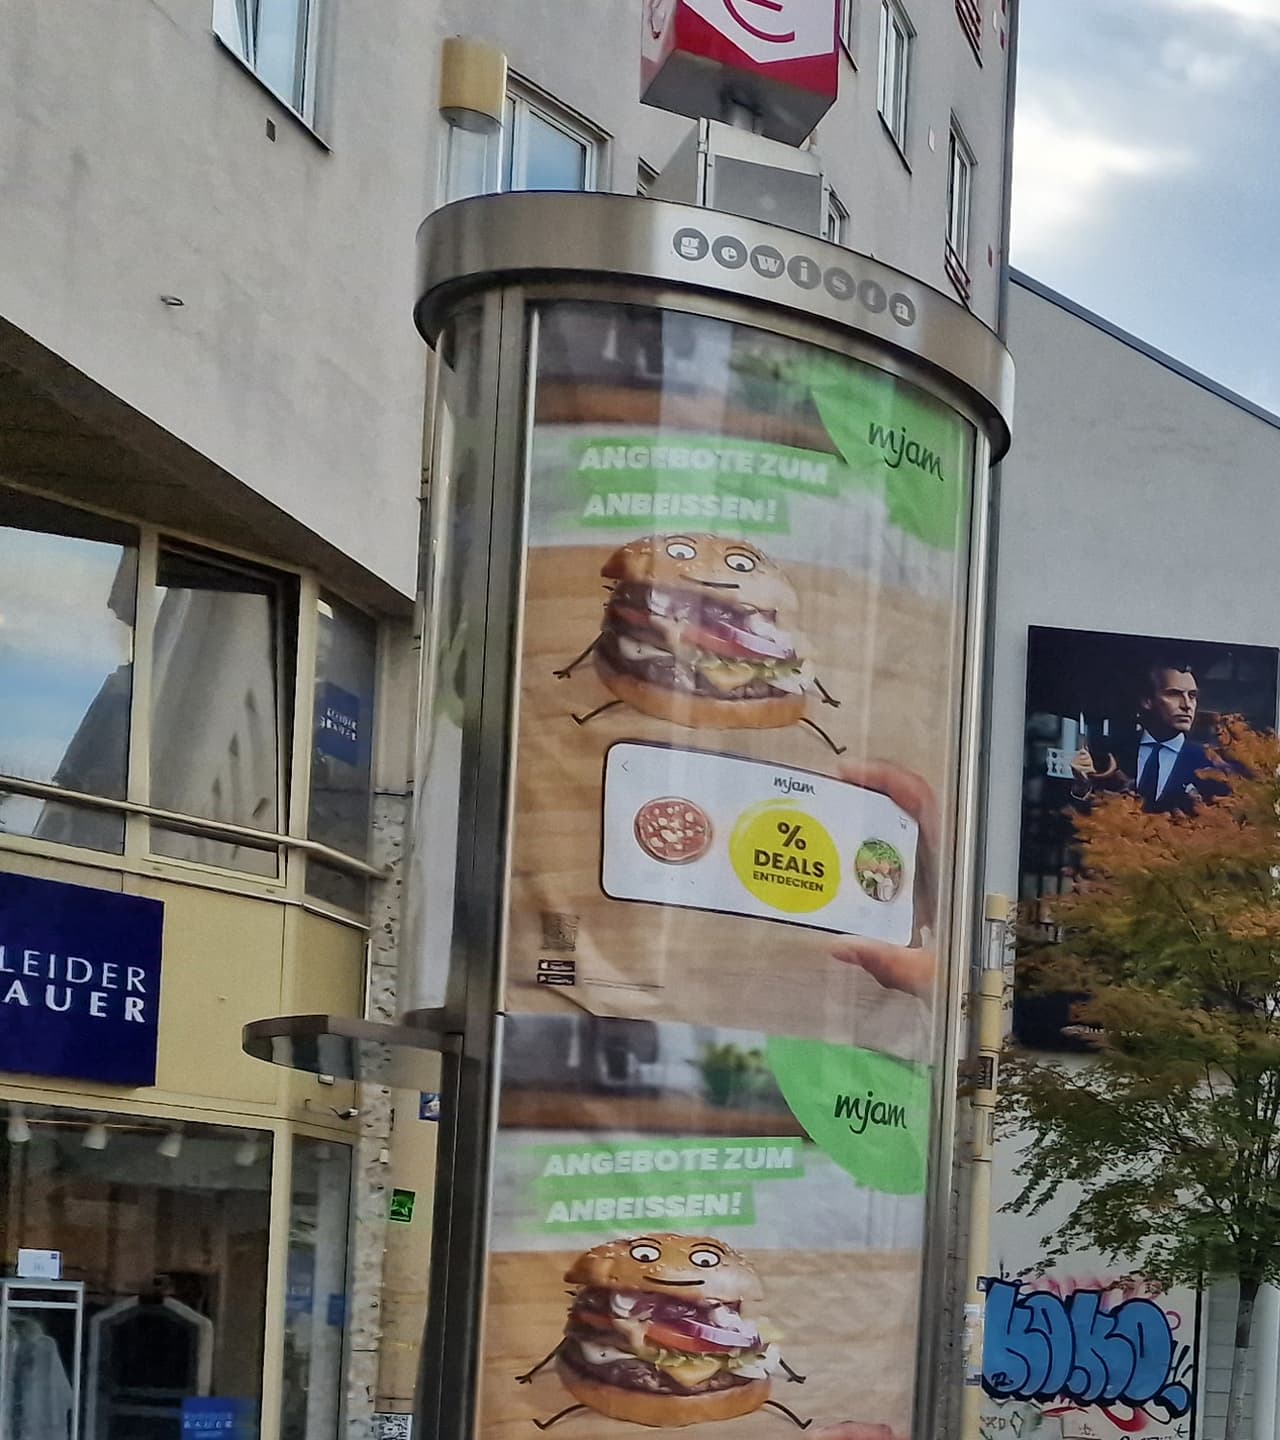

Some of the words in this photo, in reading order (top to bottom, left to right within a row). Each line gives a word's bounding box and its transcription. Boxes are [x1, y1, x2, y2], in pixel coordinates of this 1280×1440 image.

[674, 228, 917, 328] gewista
[579, 444, 758, 475] ANGEBOTE
[761, 454, 829, 487] ZUM
[868, 418, 946, 482] mjam
[583, 493, 777, 522] ANBEISSEN!
[773, 774, 817, 796] mjam
[777, 821, 807, 850] %
[753, 848, 825, 878] DEALS
[752, 869, 825, 894] ENTDECKEN
[833, 1090, 907, 1133] mjam
[543, 1148, 719, 1178] ANGEBOTE
[723, 1145, 795, 1170] ZUM
[545, 1191, 743, 1224] ANBEISSEN!
